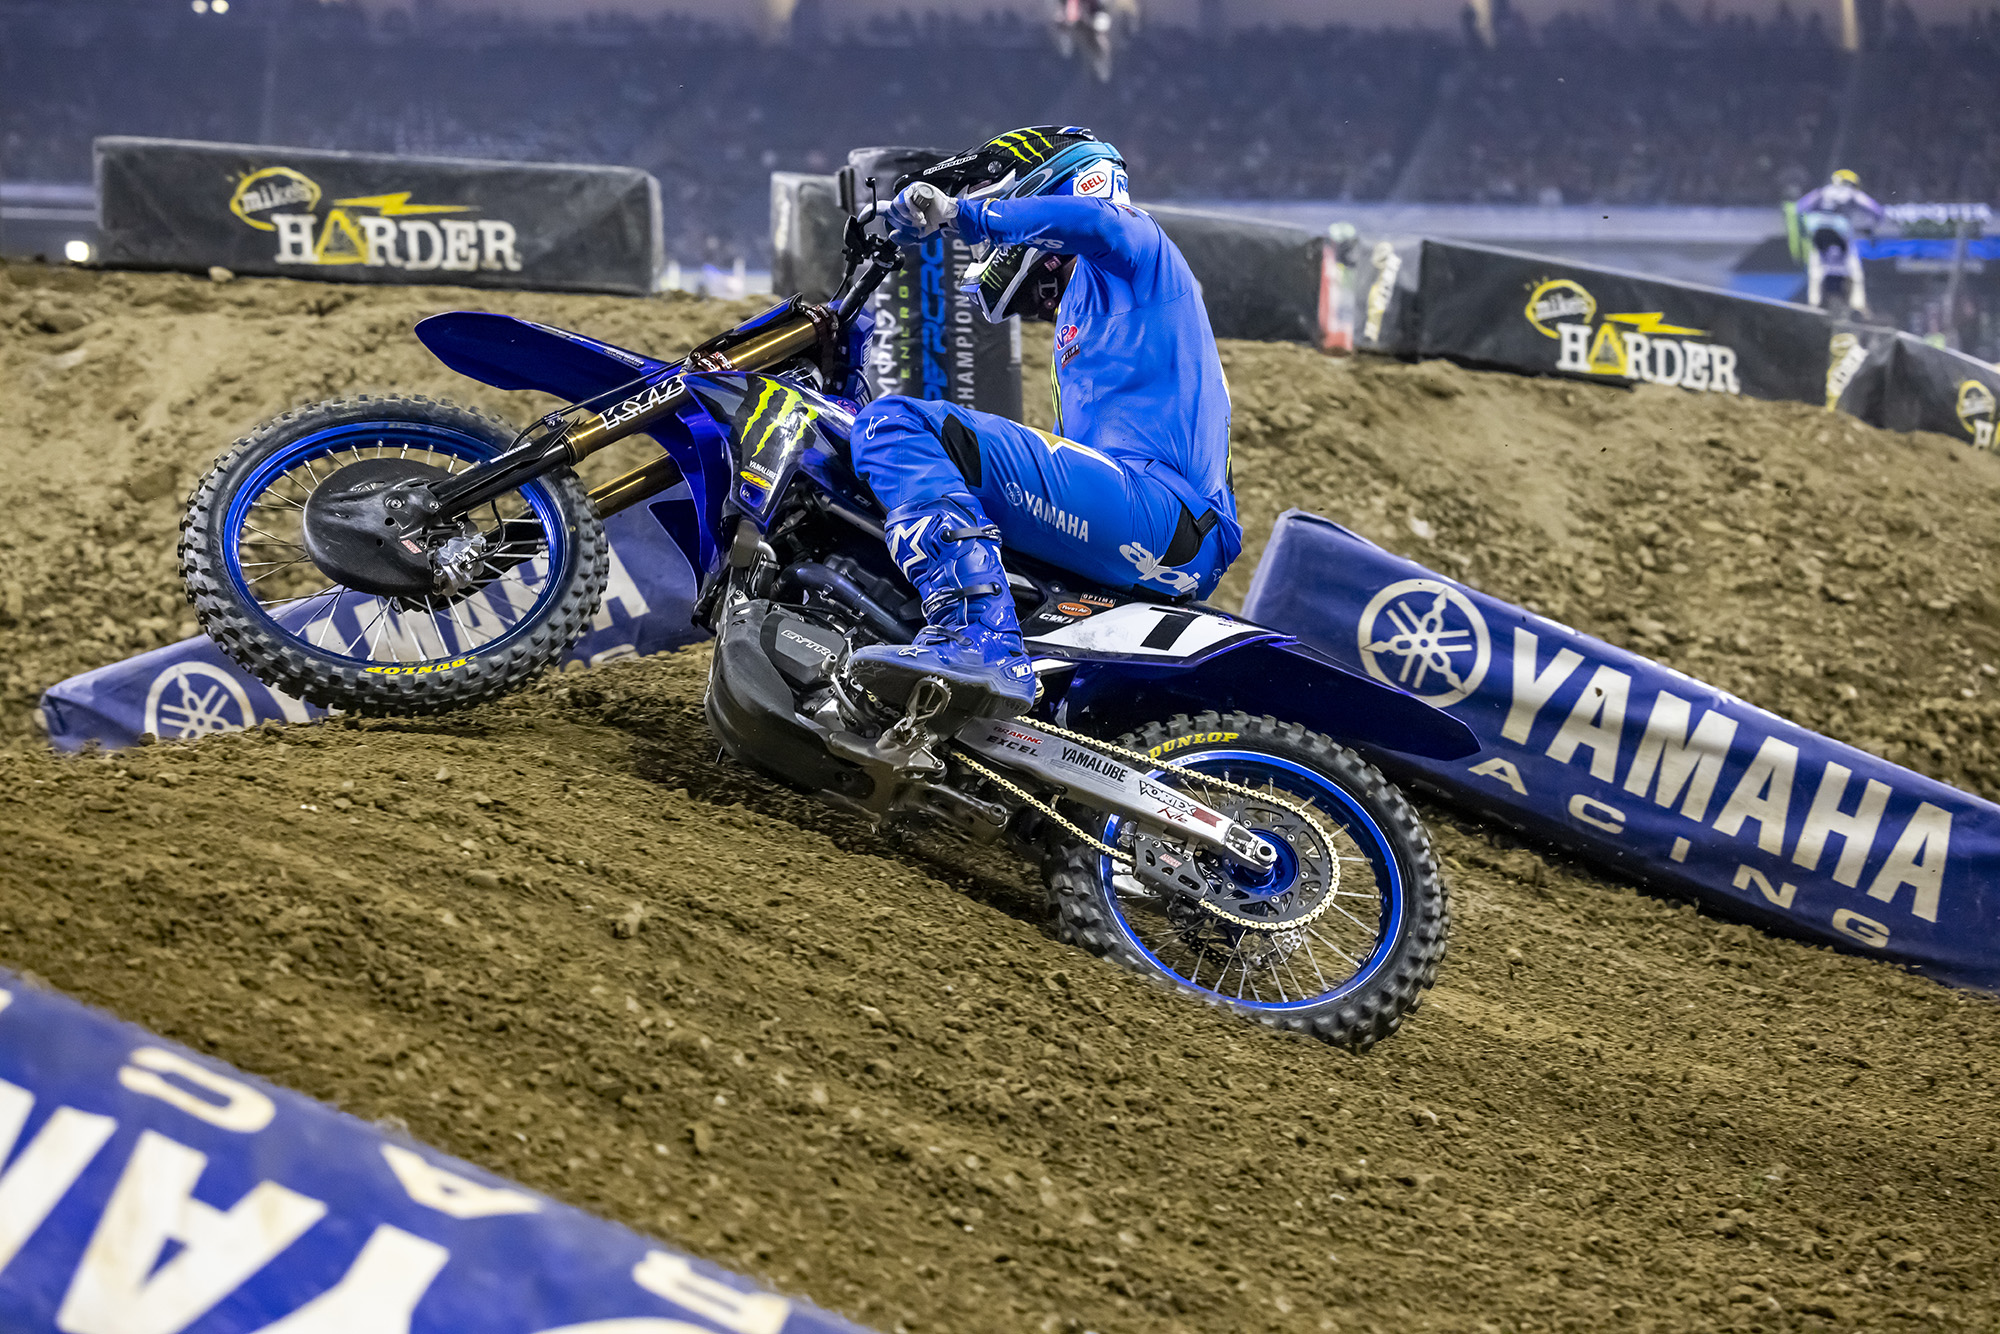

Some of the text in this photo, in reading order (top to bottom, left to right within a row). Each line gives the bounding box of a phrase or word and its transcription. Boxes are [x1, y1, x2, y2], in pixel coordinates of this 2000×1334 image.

[1080, 175, 1105, 193] BELL
[270, 209, 523, 272] HARDER
[874, 273, 898, 399] MONST
[1555, 321, 1741, 395] HARDER
[1023, 490, 1090, 544] YAMAHA
[1082, 593, 1114, 606] OPTIMA
[1139, 606, 1203, 651] 1
[365, 657, 467, 675] DUNLOP
[986, 735, 1039, 758] EXCEL
[1061, 746, 1129, 783] YAMALUBE
[1148, 732, 1240, 759] DUNLOP
[1500, 626, 1953, 923] YAMAHA
[1139, 780, 1197, 817] VORTEX
[1467, 756, 1891, 950] ACING
